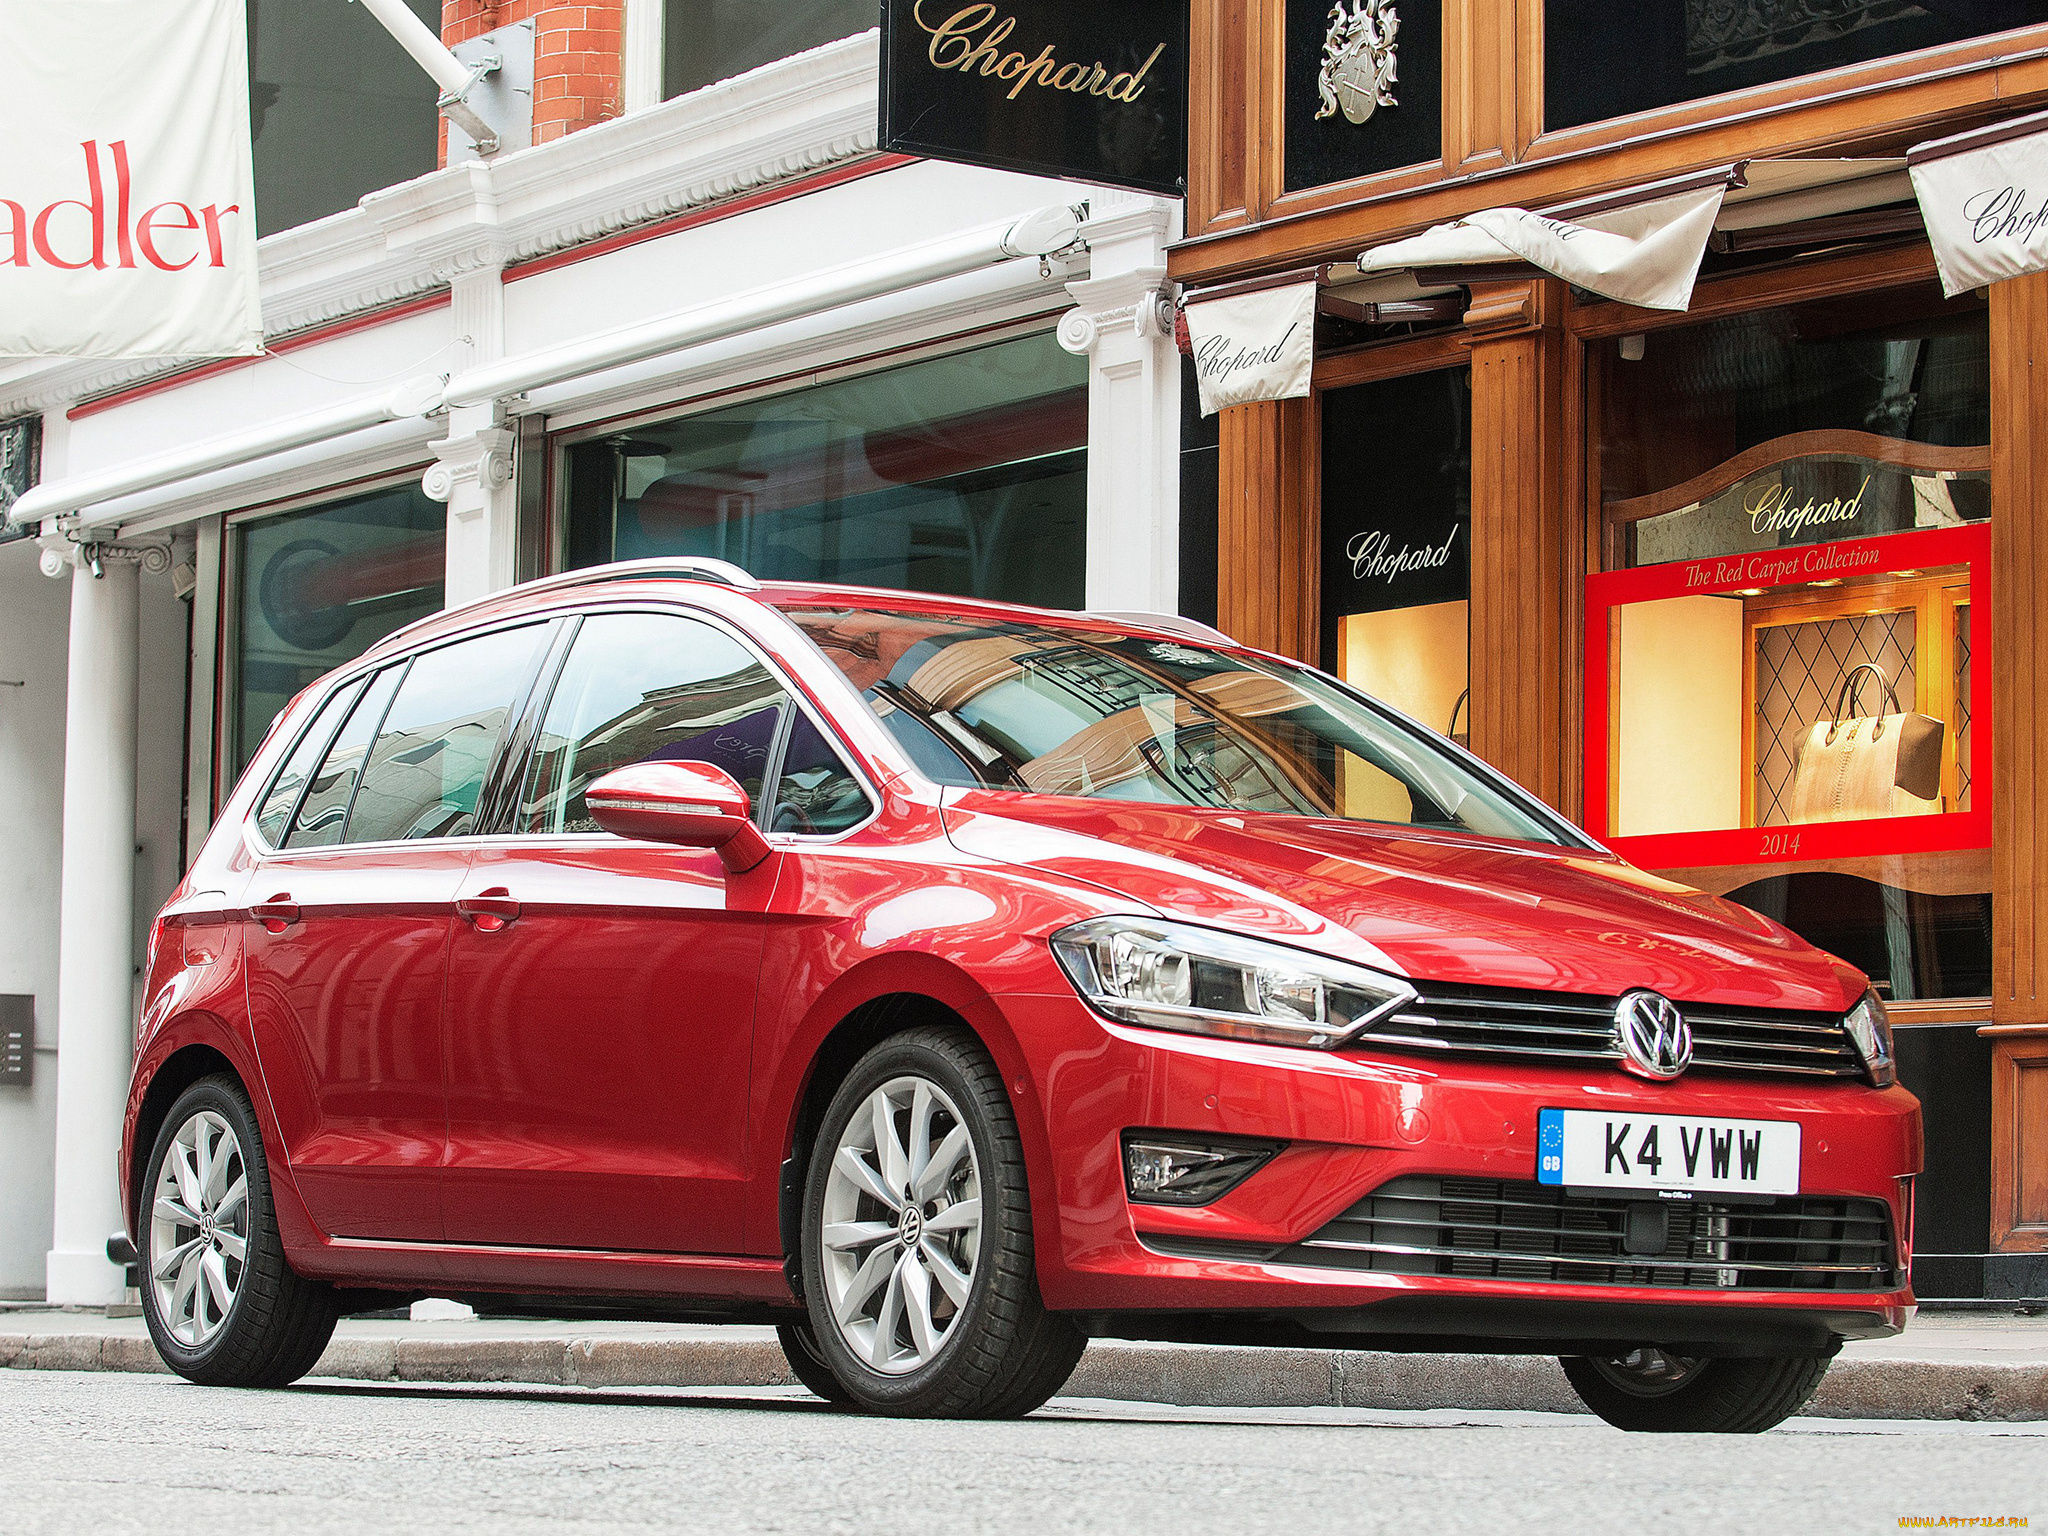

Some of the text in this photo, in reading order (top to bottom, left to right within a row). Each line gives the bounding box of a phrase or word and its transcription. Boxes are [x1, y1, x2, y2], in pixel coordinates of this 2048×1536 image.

[914, 0, 1167, 103] Chopard
[0, 139, 240, 272] adler
[1743, 474, 1871, 539] Chopard
[1346, 523, 1459, 584] Chopard
[1685, 545, 1880, 588] The Red Carpet Collection
[1759, 833, 1800, 856] 2014
[1543, 1155, 1561, 1172] GB
[1604, 1122, 1762, 1181] K4 VWW
